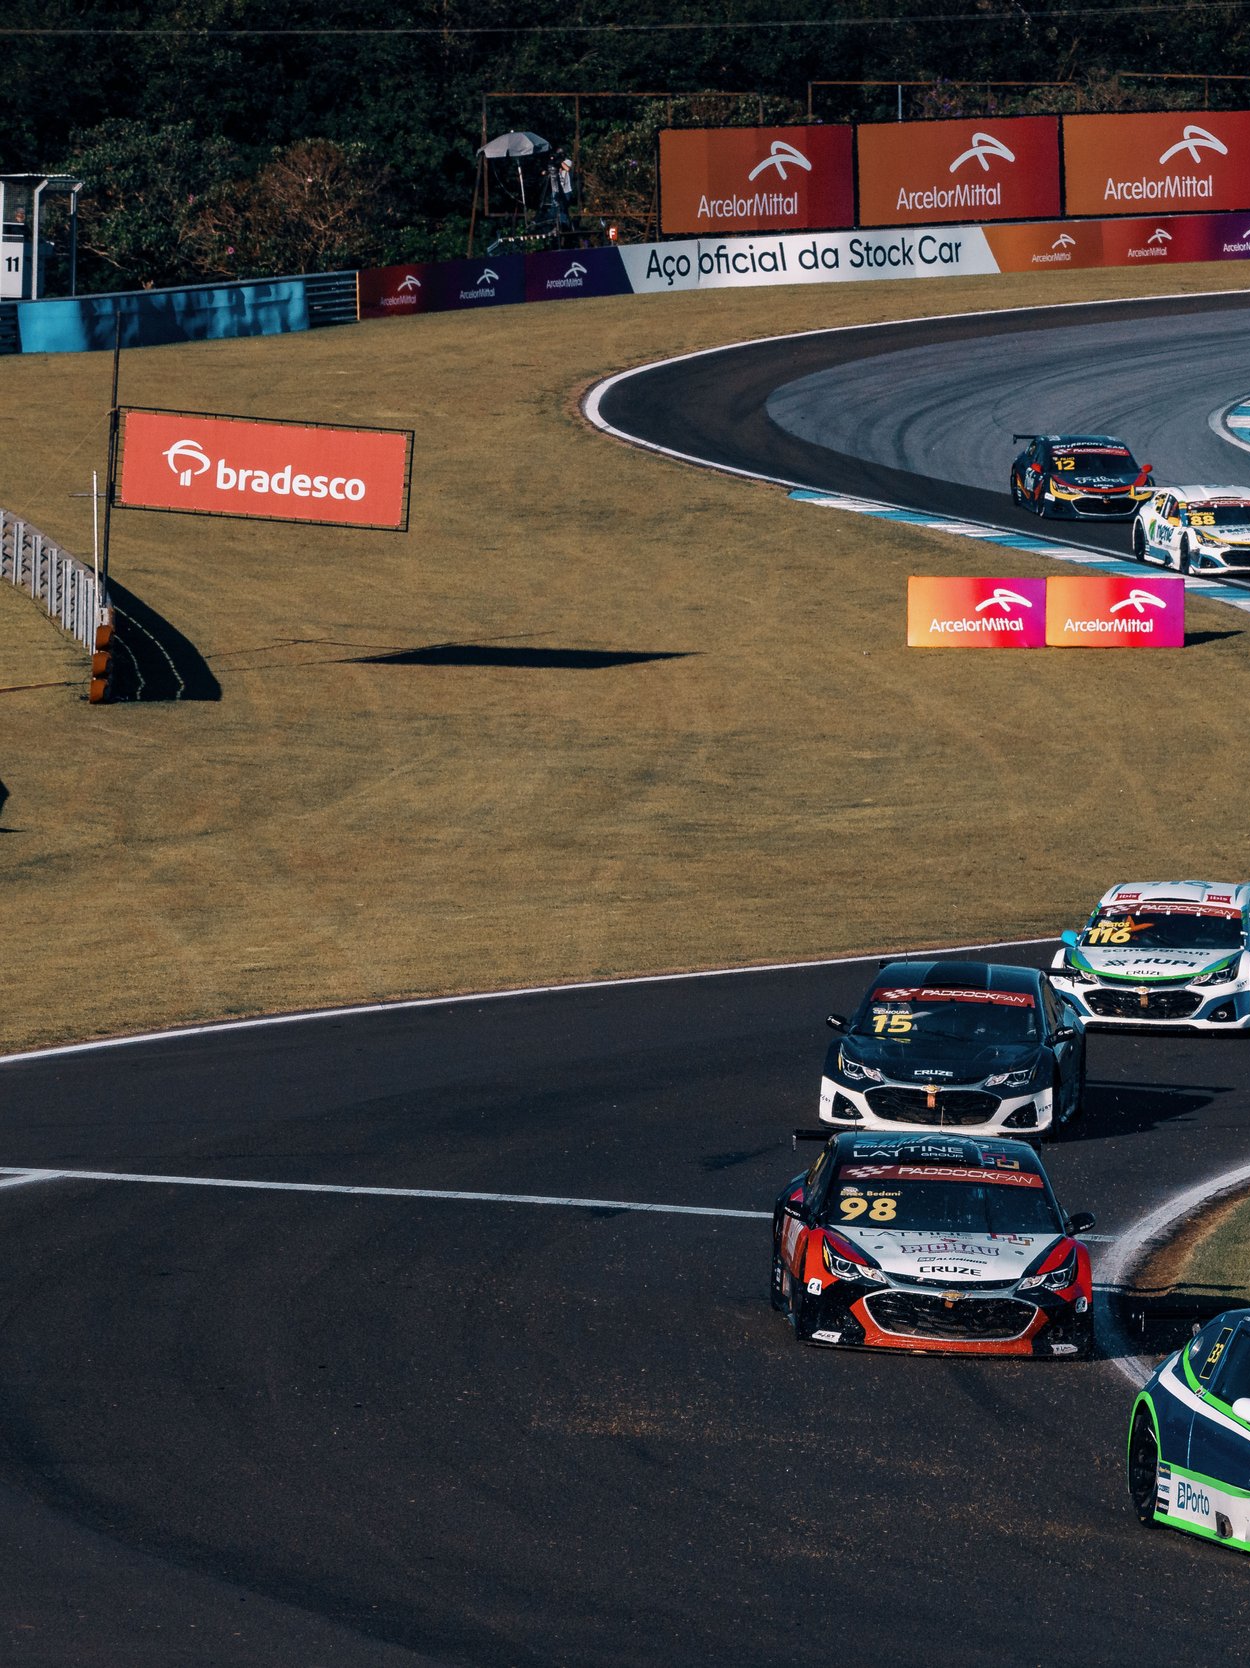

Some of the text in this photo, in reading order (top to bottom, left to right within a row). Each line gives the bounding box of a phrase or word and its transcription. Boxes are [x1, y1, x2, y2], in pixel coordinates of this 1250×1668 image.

[1104, 173, 1213, 201] ArcelorMittal
[896, 182, 1001, 210] ArcelorMittal
[697, 191, 799, 219] ArcelorMittal
[609, 228, 616, 238] F
[1031, 250, 1072, 263] ArcelorMittal
[1127, 244, 1168, 257] ArcelorMittal
[5, 256, 19, 272] 11
[646, 234, 962, 286] Aço oficial da Stock Car
[546, 276, 583, 290] ArcelorMittal
[1055, 460, 1075, 471] 12
[216, 458, 366, 502] bradesco
[1190, 515, 1216, 526] 88
[930, 617, 1024, 633] ArcelorMittal
[1064, 618, 1154, 633] ArcelorMittal
[1139, 904, 1235, 917] PADDOCKFAN
[1088, 927, 1132, 944] 116
[1133, 957, 1197, 968] HUPI
[921, 989, 1026, 1003] PADDOCKFAN
[872, 1014, 913, 1033] 15
[914, 1069, 954, 1077] CRUZE
[898, 1167, 1034, 1184] PADDOCKFAN
[839, 1198, 897, 1222] 98
[919, 1266, 982, 1277] CRUZE
[1206, 1342, 1225, 1364] 33
[1185, 1483, 1210, 1516] Porto
